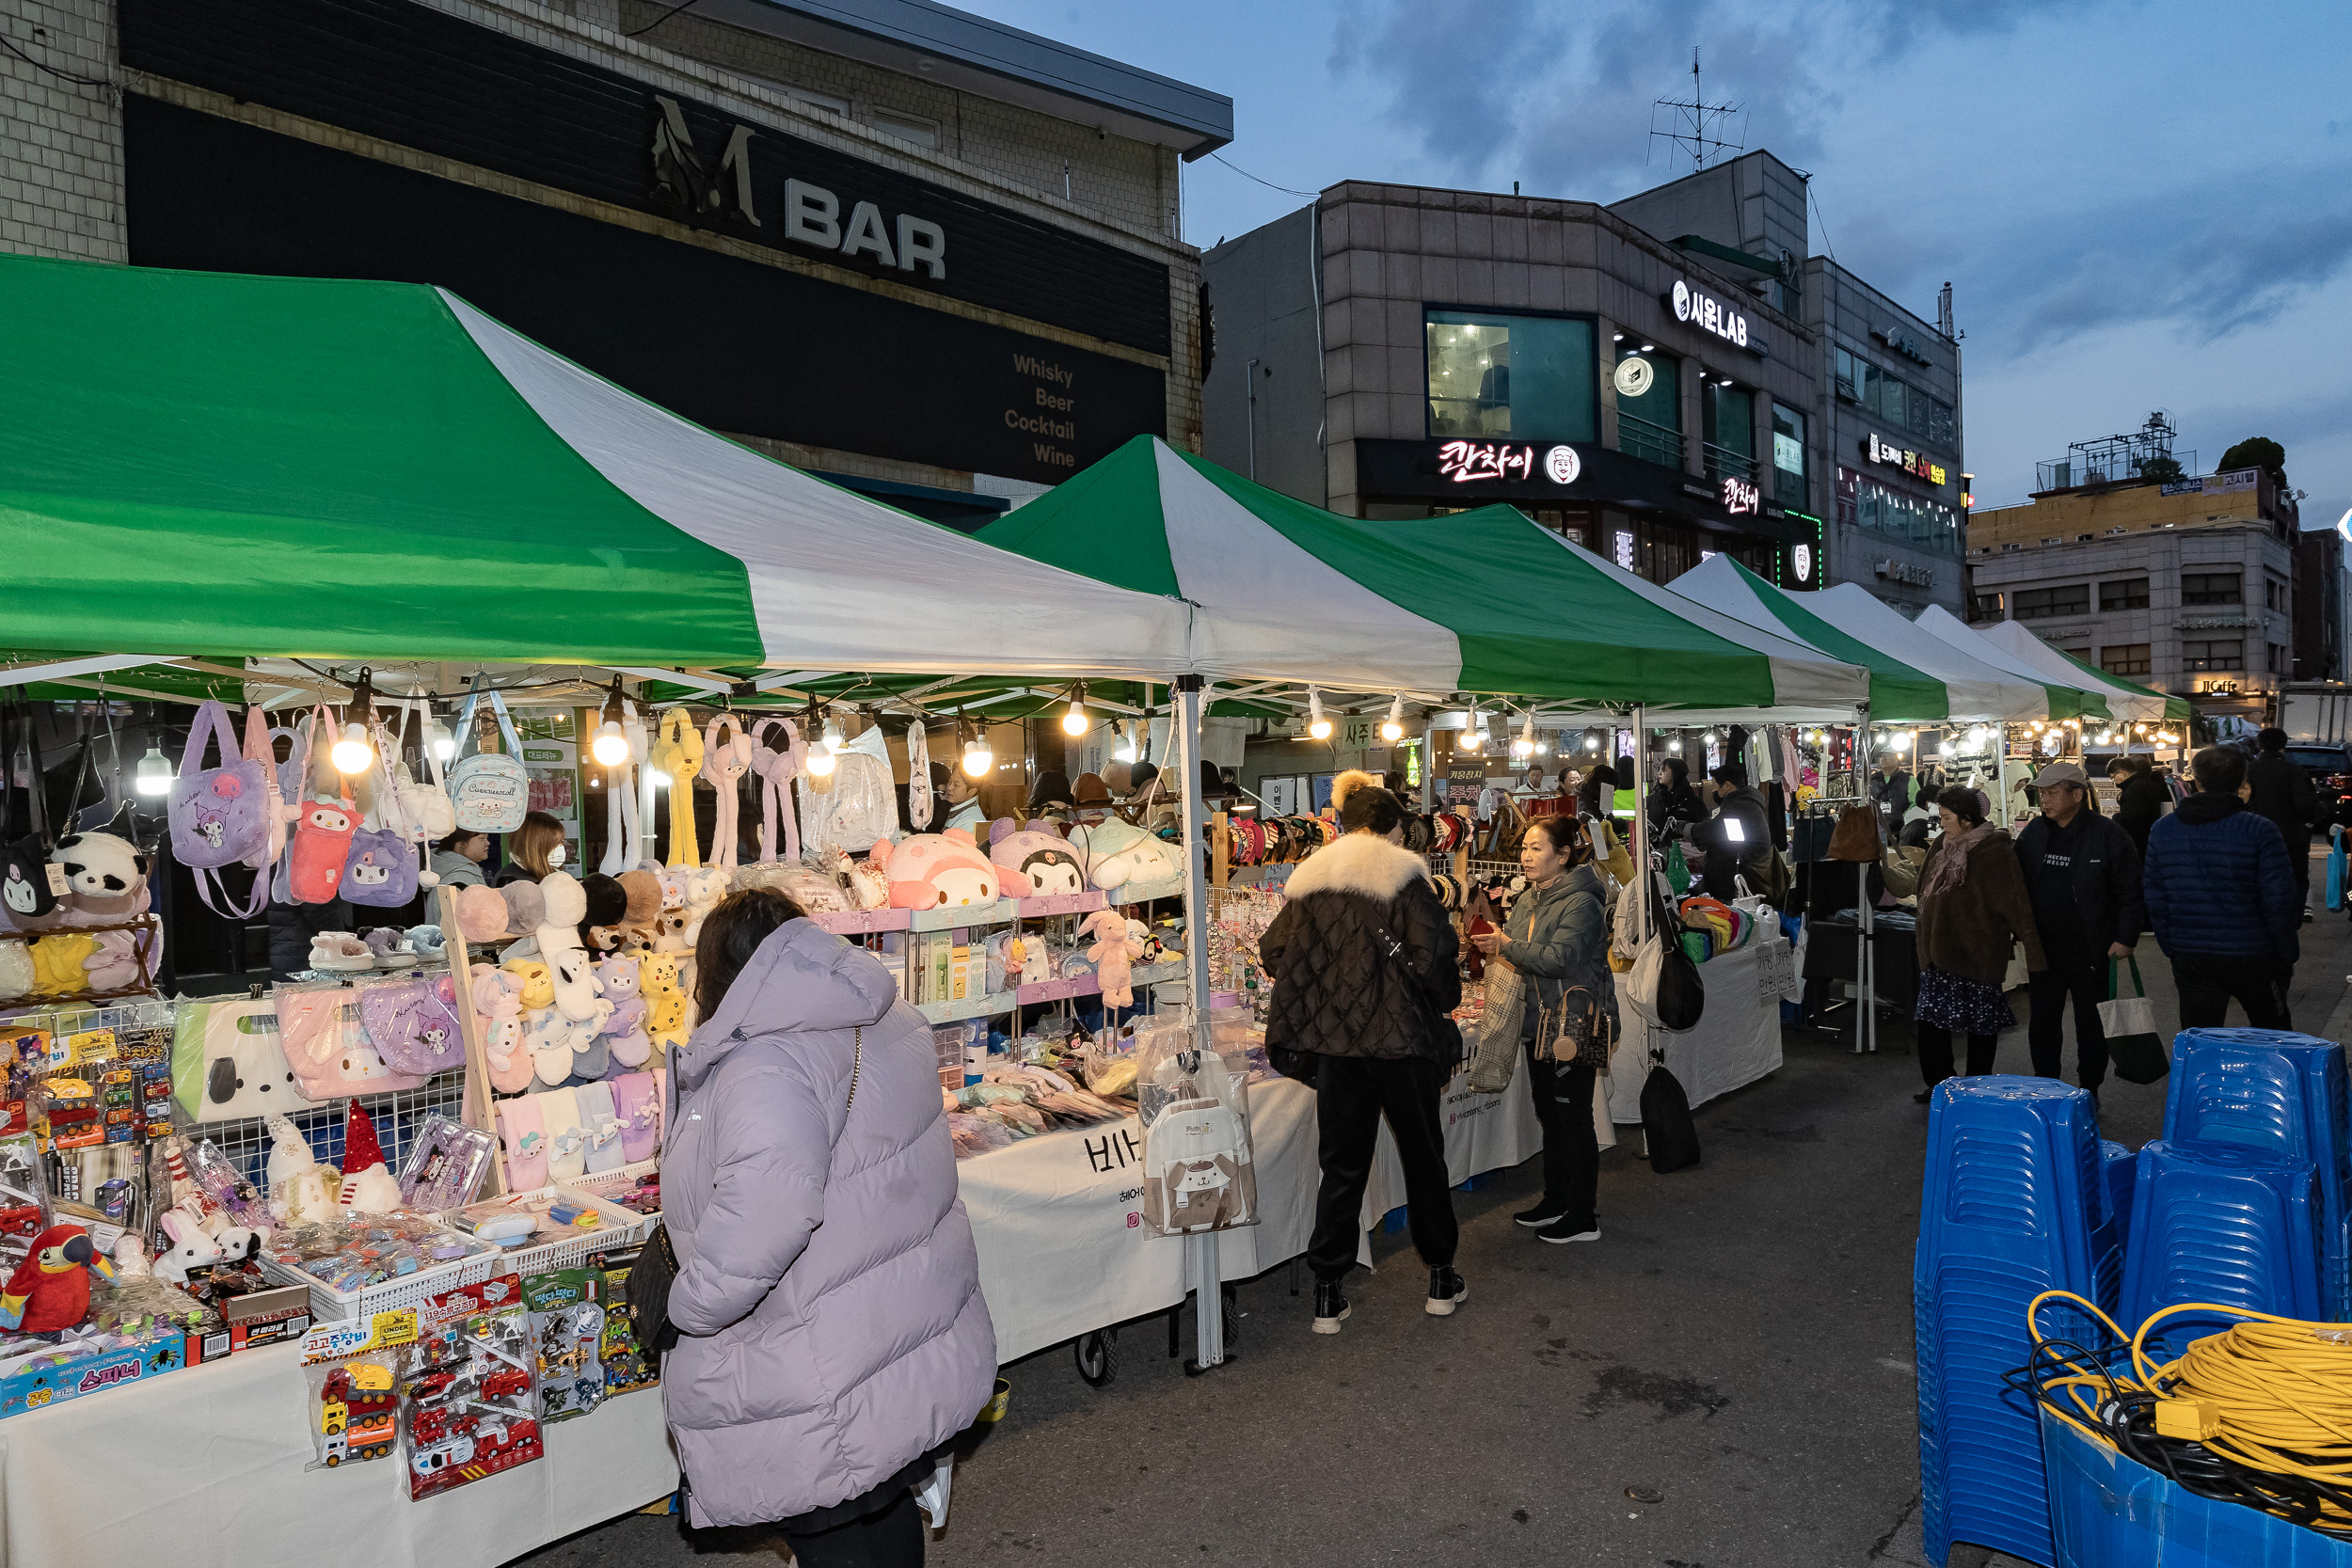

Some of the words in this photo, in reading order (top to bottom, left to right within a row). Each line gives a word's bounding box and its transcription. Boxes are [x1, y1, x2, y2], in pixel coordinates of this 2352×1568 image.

[784, 177, 946, 281] BAR
[1012, 353, 1073, 388] Whisky
[1035, 387, 1074, 413] Beer
[1004, 409, 1075, 441] Cocktail
[1033, 442, 1075, 468] Wine
[1881, 443, 1902, 466] 도깨비
[1903, 450, 1916, 474] 코인
[1345, 723, 1369, 745] 사주
[1757, 953, 1773, 971] 가방
[1777, 949, 1792, 967] 가방
[1759, 975, 1776, 995] 만원
[1779, 971, 1796, 991] 만원
[81, 1044, 106, 1053] UNDER
[383, 1323, 408, 1334] UNDER
[308, 1331, 367, 1352] 고고중장비
[26, 1387, 53, 1407] 곤충
[79, 1358, 142, 1393] 스피너
